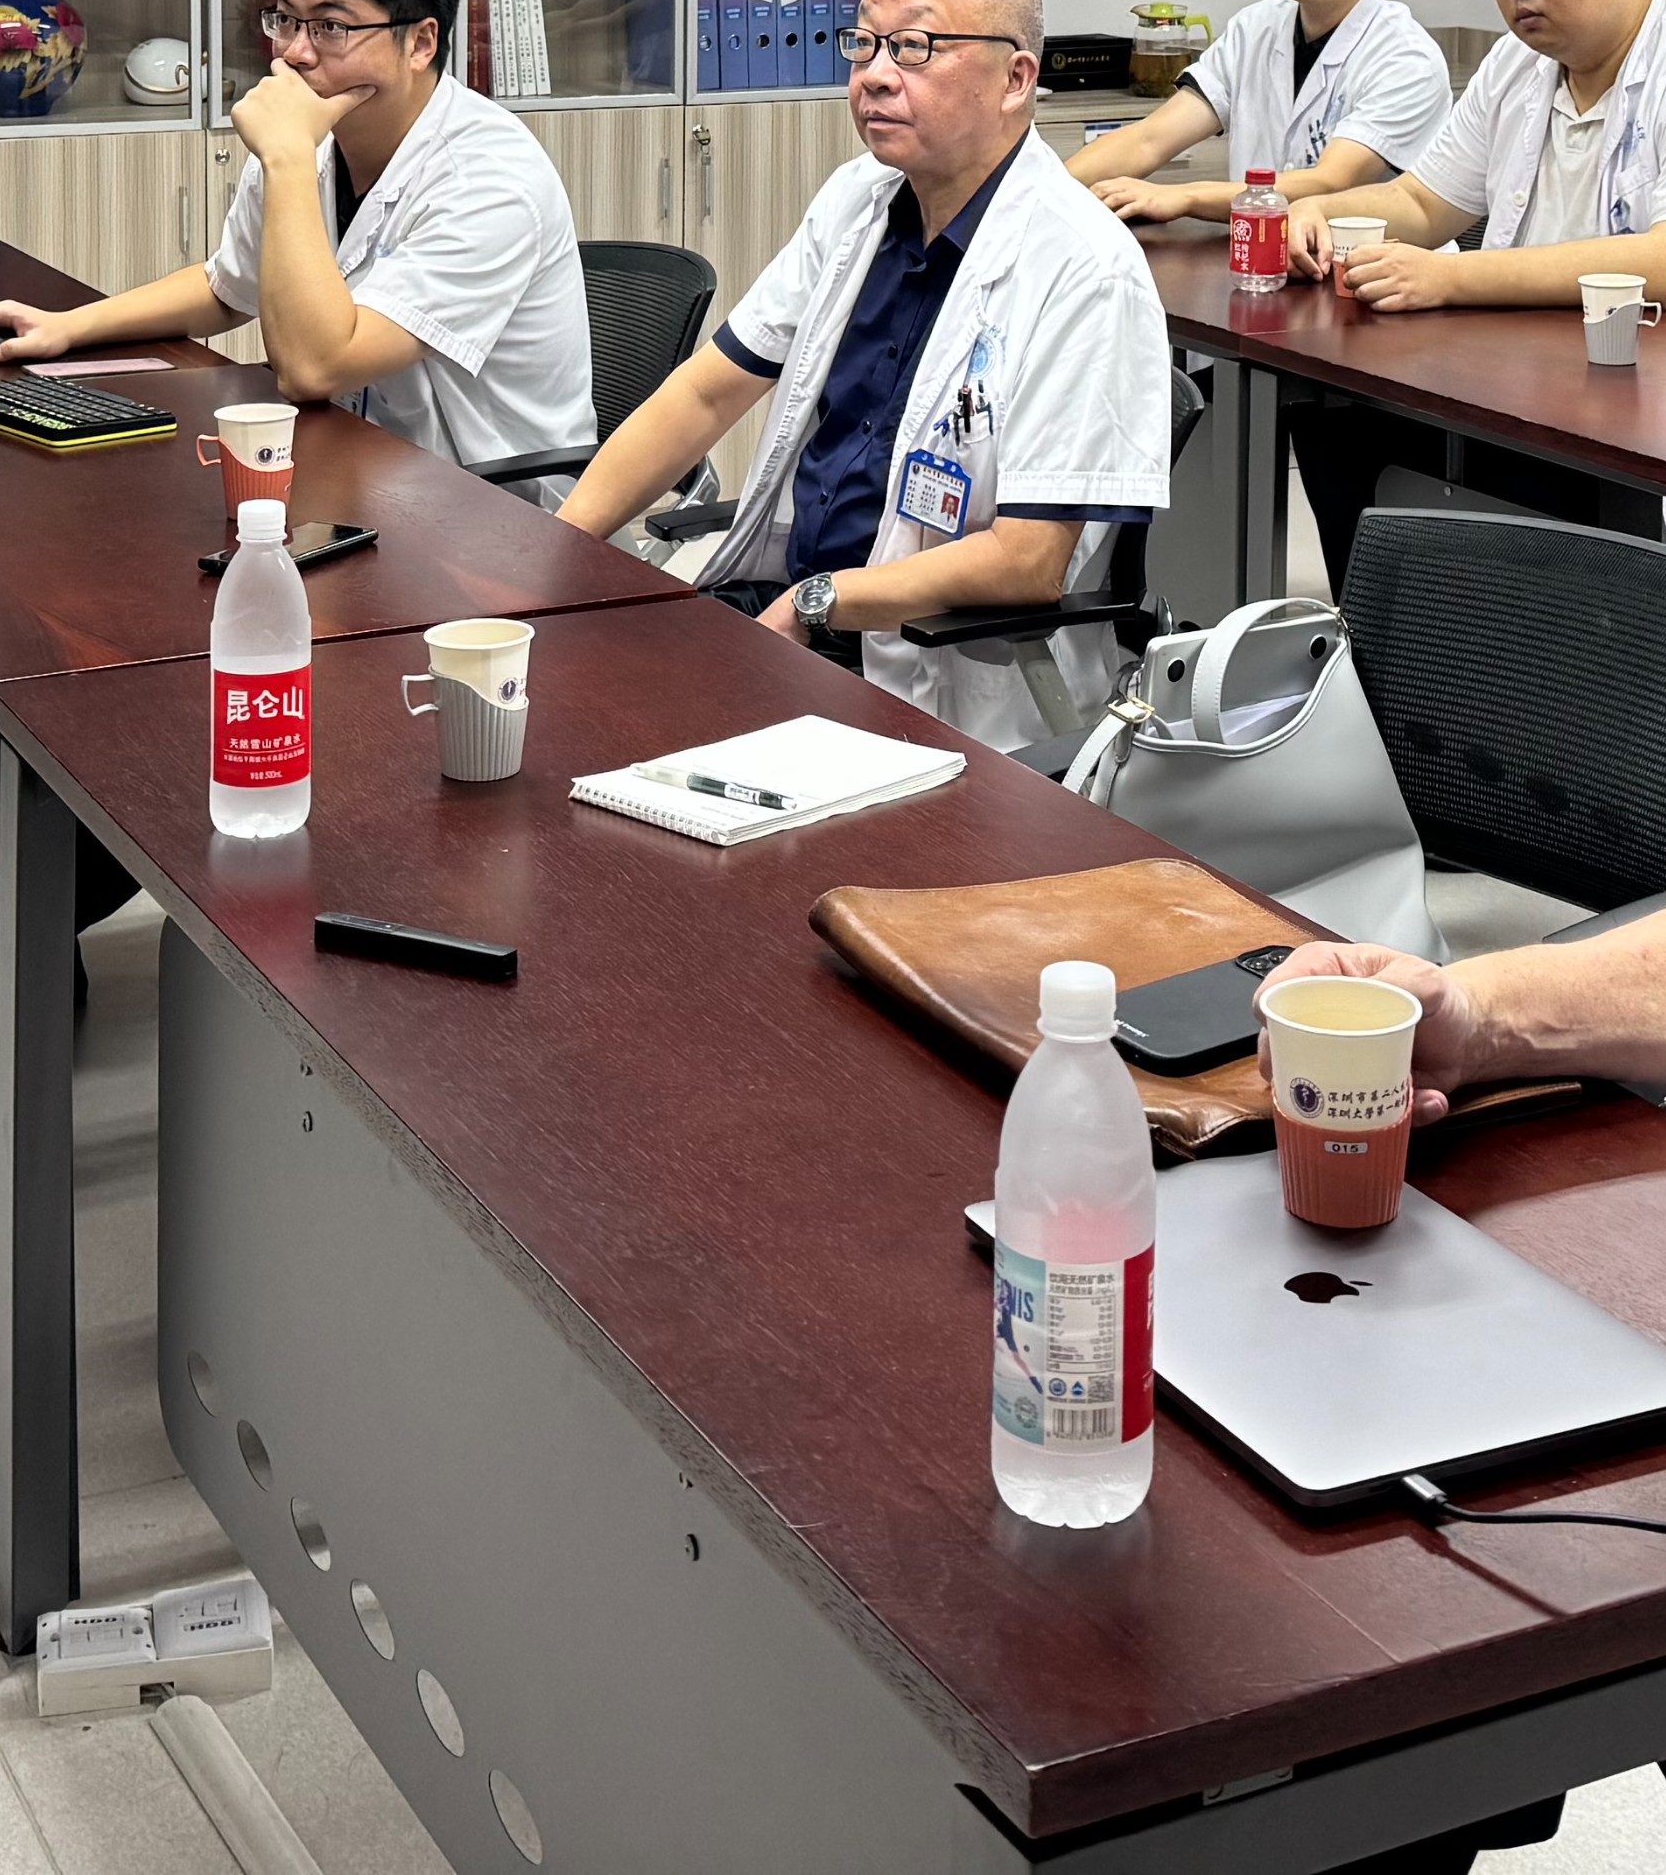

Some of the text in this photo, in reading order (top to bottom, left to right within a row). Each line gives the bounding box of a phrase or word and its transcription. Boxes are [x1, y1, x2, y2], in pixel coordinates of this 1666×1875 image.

[226, 685, 304, 725] 昆仑山
[229, 733, 301, 749] 天然雪山矿泉水
[1331, 1143, 1359, 1153] 015
